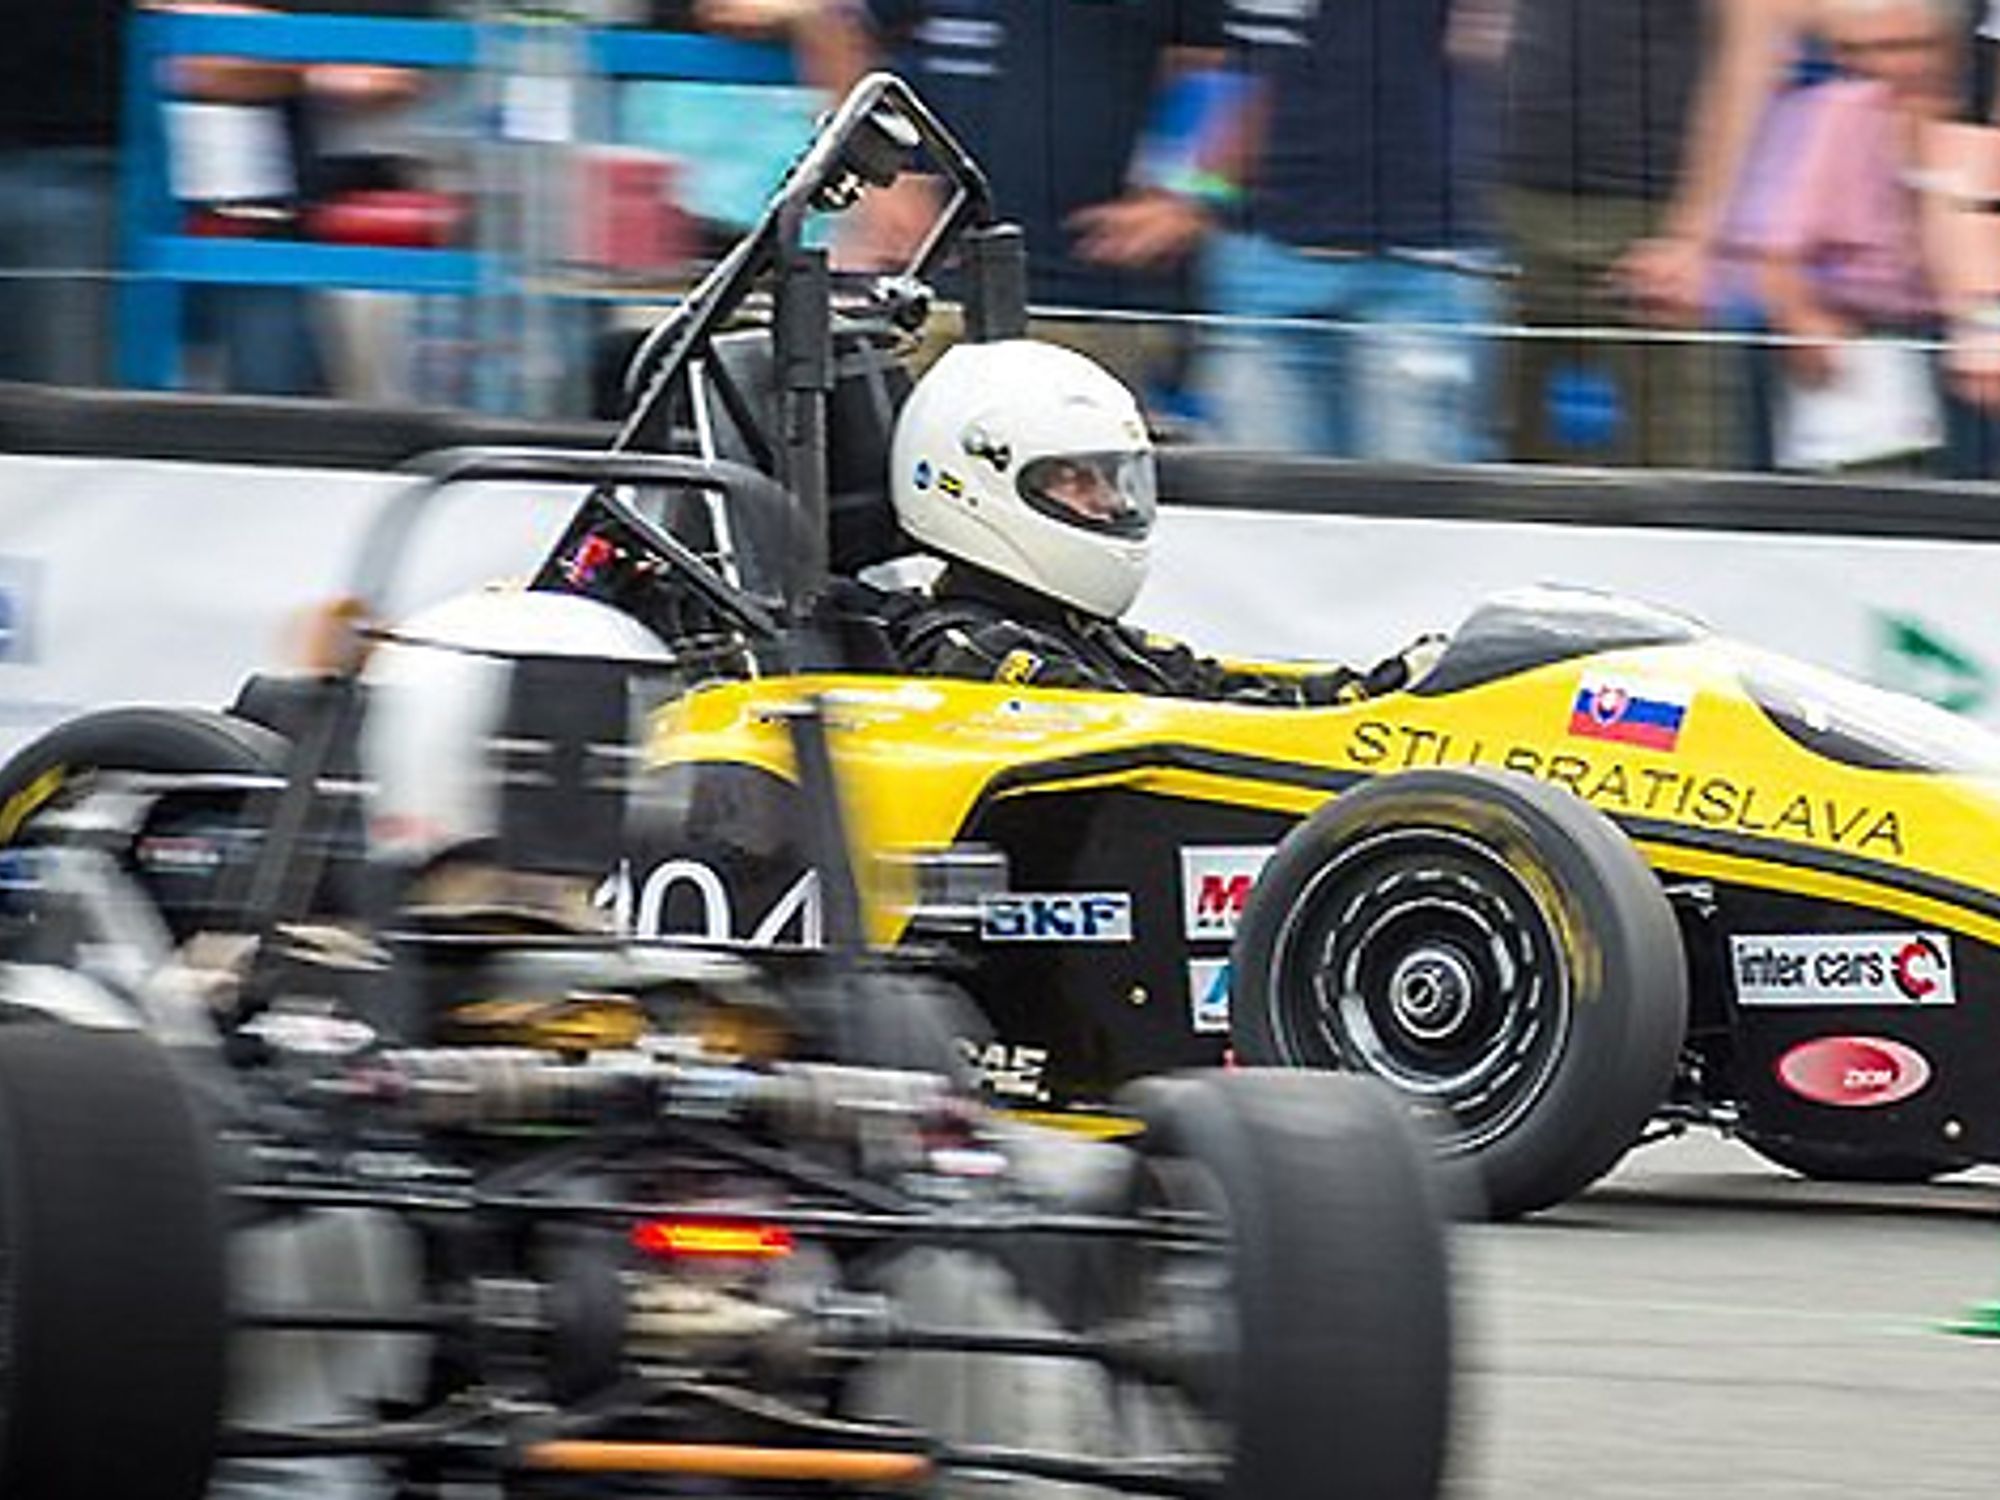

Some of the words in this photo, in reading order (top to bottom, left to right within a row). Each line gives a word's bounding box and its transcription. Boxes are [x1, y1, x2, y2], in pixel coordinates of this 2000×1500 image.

[985, 900, 1127, 936] SKF
[1736, 943, 1807, 987] inter
[1813, 952, 1883, 987] cars
